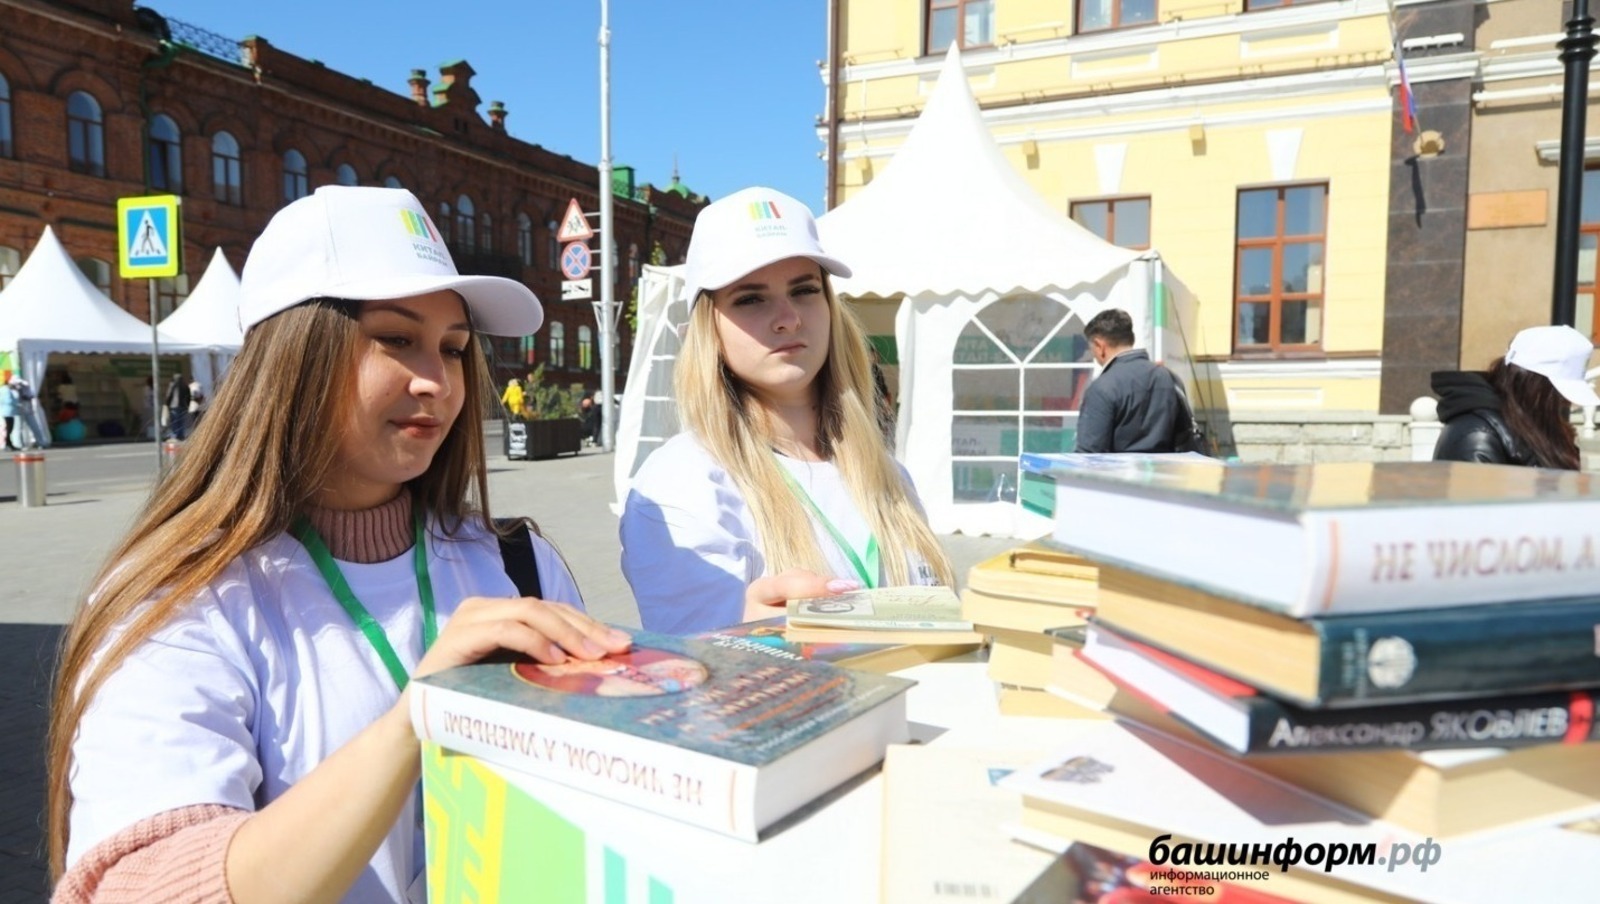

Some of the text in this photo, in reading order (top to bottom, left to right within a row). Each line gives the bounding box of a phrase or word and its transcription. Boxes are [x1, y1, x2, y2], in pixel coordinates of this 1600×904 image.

[1371, 541, 1415, 582] НЕ
[1574, 534, 1596, 570] А
[442, 710, 539, 760] УМЕНЬЕМ!
[1268, 707, 1569, 747] Александр ЯКОВЛЕВ
[543, 737, 557, 762] А
[674, 773, 703, 806] НЕ
